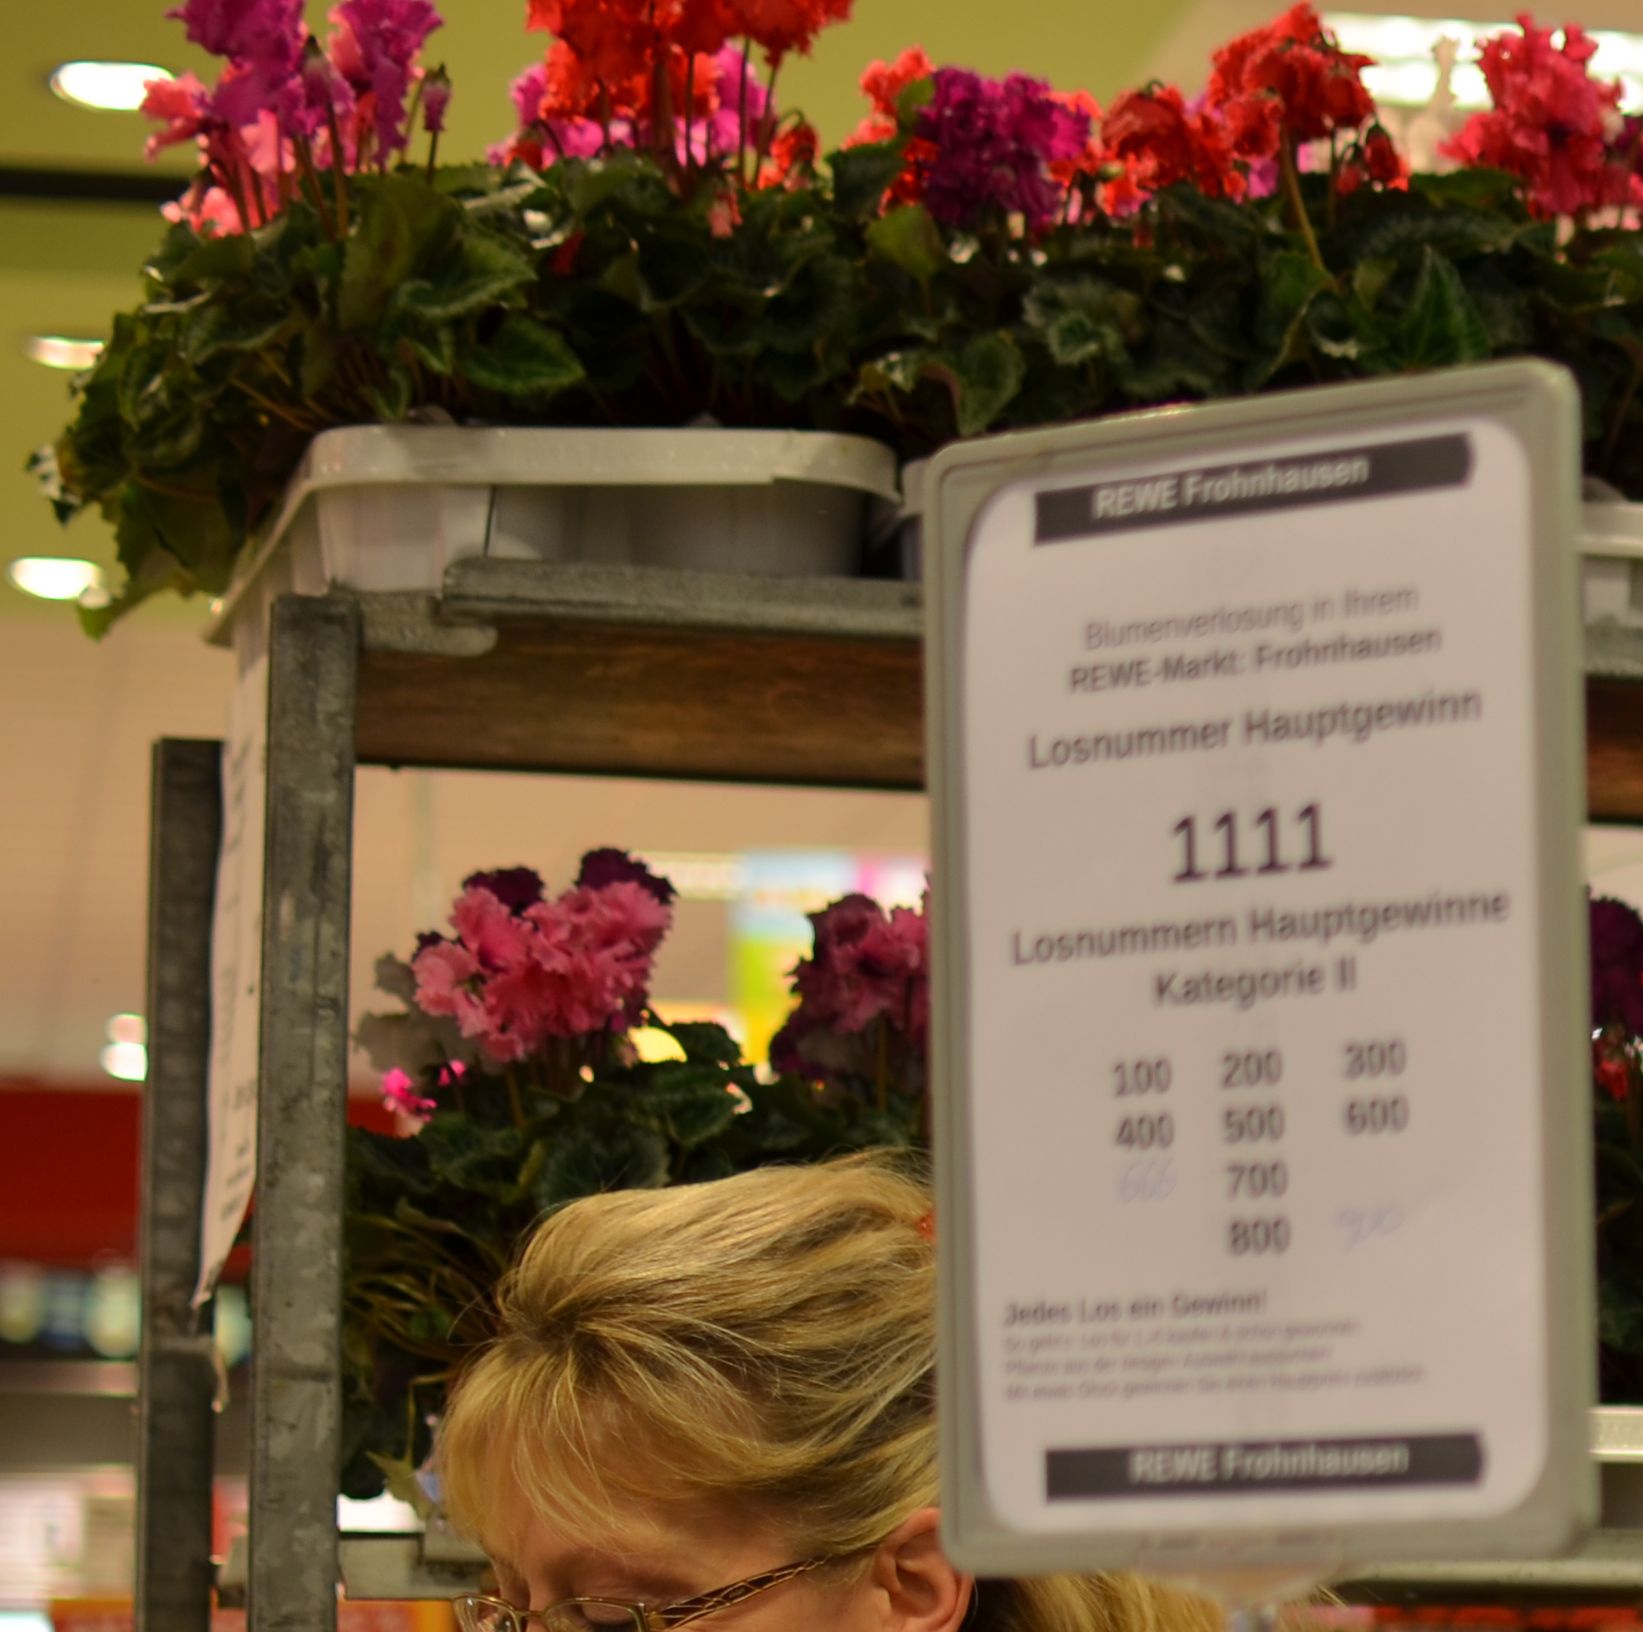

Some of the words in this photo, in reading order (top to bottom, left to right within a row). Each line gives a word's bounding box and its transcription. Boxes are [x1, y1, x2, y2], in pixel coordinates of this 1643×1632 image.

[1093, 478, 1177, 518] REWE
[1185, 454, 1370, 505] Frohnhausen
[1086, 600, 1303, 650] Blumenverlosung
[1312, 594, 1335, 621] in
[1342, 586, 1418, 619] Ihrem
[1254, 627, 1442, 671] Frohnhausen
[1028, 714, 1231, 770] Losnummer
[1244, 688, 1482, 746] Hauptgewinn
[1171, 804, 1333, 884] 1111
[1012, 914, 1237, 967] Losnummern
[1250, 887, 1511, 947] Hauptgewinne
[1154, 964, 1324, 1009] Kategorie
[1112, 1057, 1172, 1098] 100
[1221, 1049, 1283, 1090] 200
[1342, 1039, 1407, 1081] 300
[1114, 1112, 1175, 1151] 400
[1223, 1104, 1285, 1142] 500
[1343, 1095, 1409, 1136] 600
[1227, 1161, 1289, 1199] 700
[1228, 1217, 1291, 1256] 800
[1004, 1299, 1071, 1328] Jedes
[1079, 1297, 1122, 1323] Los
[1129, 1295, 1164, 1320] ein
[1128, 1447, 1217, 1483] REWE
[1220, 1444, 1410, 1480] Frohnhausen
